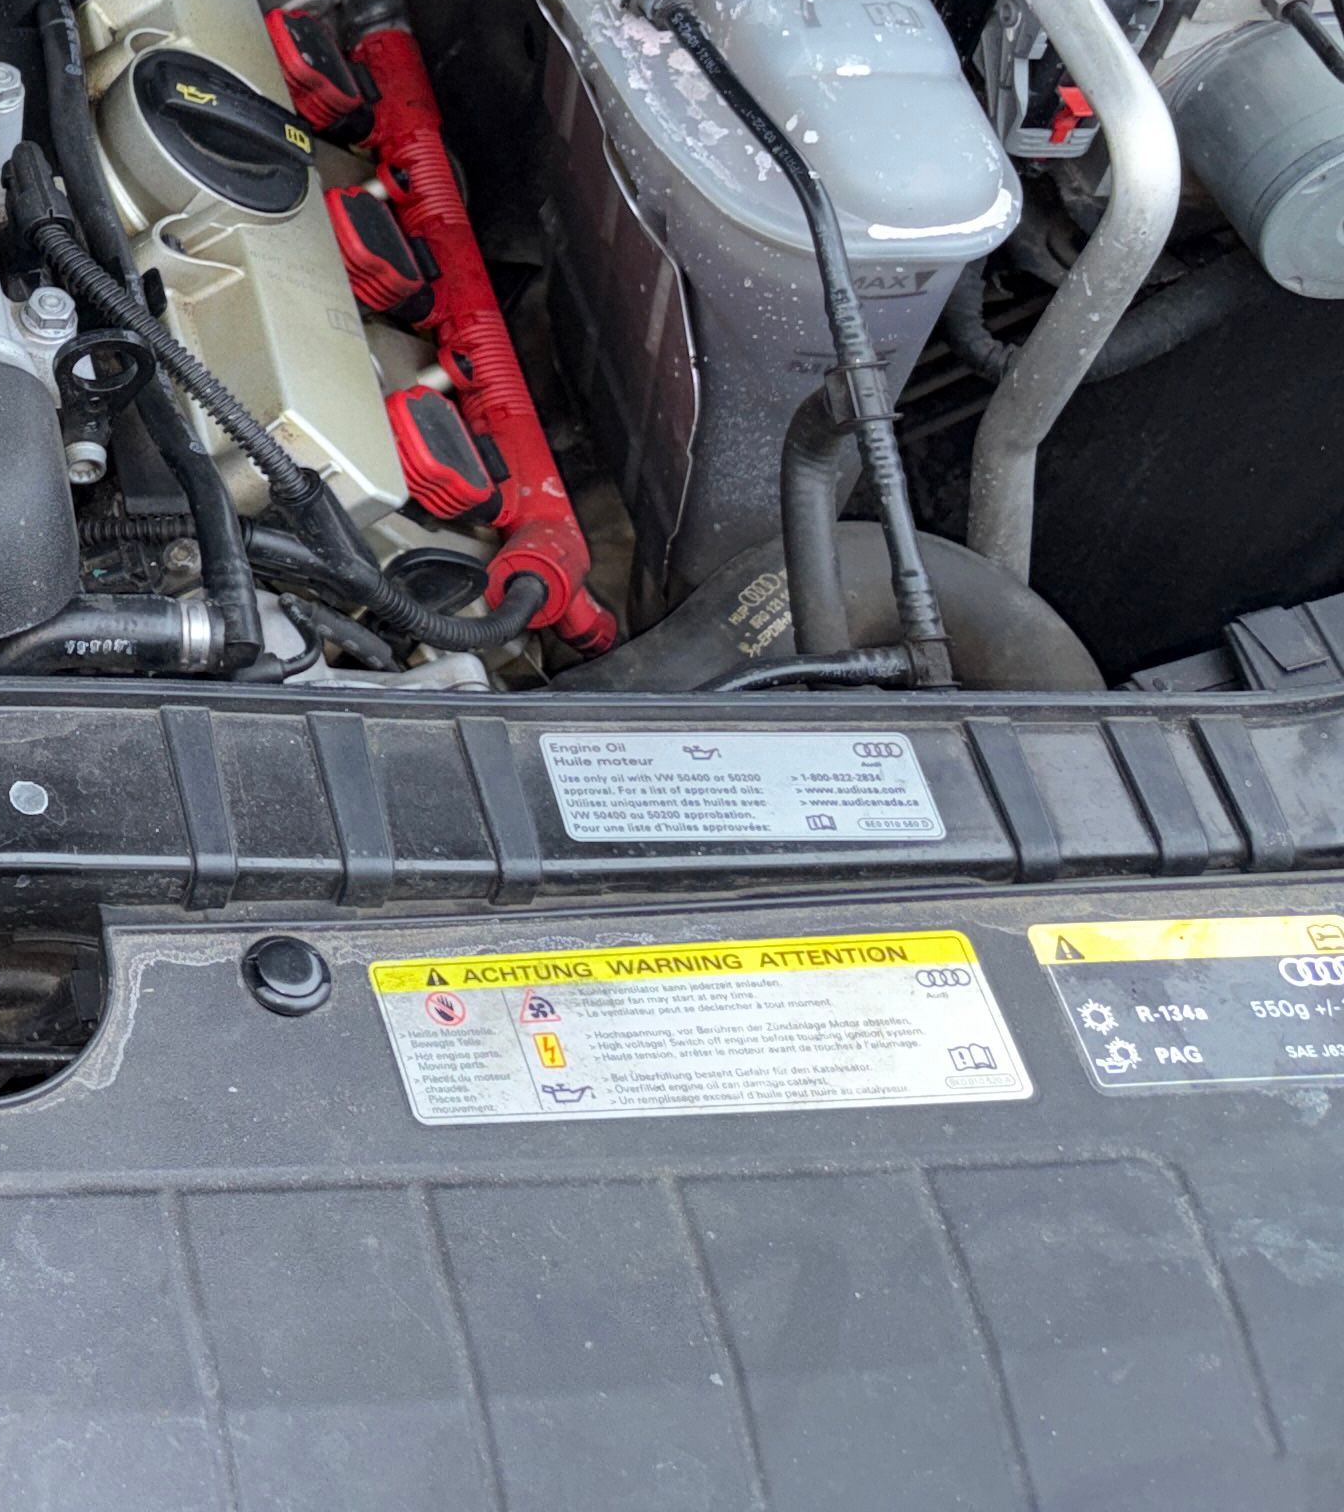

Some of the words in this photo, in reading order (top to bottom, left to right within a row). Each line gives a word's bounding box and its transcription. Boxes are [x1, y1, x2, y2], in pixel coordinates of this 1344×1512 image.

[549, 743, 601, 754] Engine
[606, 743, 626, 752] Oil
[554, 757, 592, 766] Huile
[597, 758, 654, 766] moteur
[558, 774, 579, 783] Use
[584, 774, 607, 784] only
[611, 774, 625, 782] oil
[627, 774, 652, 782] with
[655, 774, 673, 782] VW
[677, 774, 710, 782] 50400
[728, 773, 761, 782] 50200
[564, 787, 615, 797] approval.
[618, 787, 636, 795] For
[649, 787, 666, 795] list
[669, 787, 682, 795] of
[685, 786, 737, 796] approved
[740, 786, 764, 795] oils:
[806, 786, 906, 795] www.audiusa.com
[566, 799, 608, 808] Utilisez
[610, 799, 678, 809] uniquement
[681, 798, 701, 807] des
[704, 798, 738, 807] huiles
[810, 798, 919, 806] www.audicanada.ca
[571, 811, 590, 820] VW
[593, 811, 626, 820] 50400
[630, 812, 644, 820] ou
[647, 811, 681, 820] 50200
[684, 811, 756, 821] approbation.
[574, 824, 600, 833] Pour
[627, 823, 652, 832] liste
[462, 961, 593, 984] ACHTUNG
[606, 953, 743, 976] WARNING
[759, 945, 909, 969] ATTENTION
[647, 996, 668, 1004] may
[672, 995, 695, 1003] start
[710, 993, 727, 1001] any
[1135, 1005, 1208, 1023] R-134a
[1250, 999, 1310, 1020] 550g
[598, 1041, 623, 1051] High
[670, 1037, 705, 1047] Switch
[707, 1036, 721, 1044] off
[724, 1035, 758, 1045] engine
[1154, 1046, 1203, 1064] PAG
[1285, 1045, 1318, 1058] SAE
